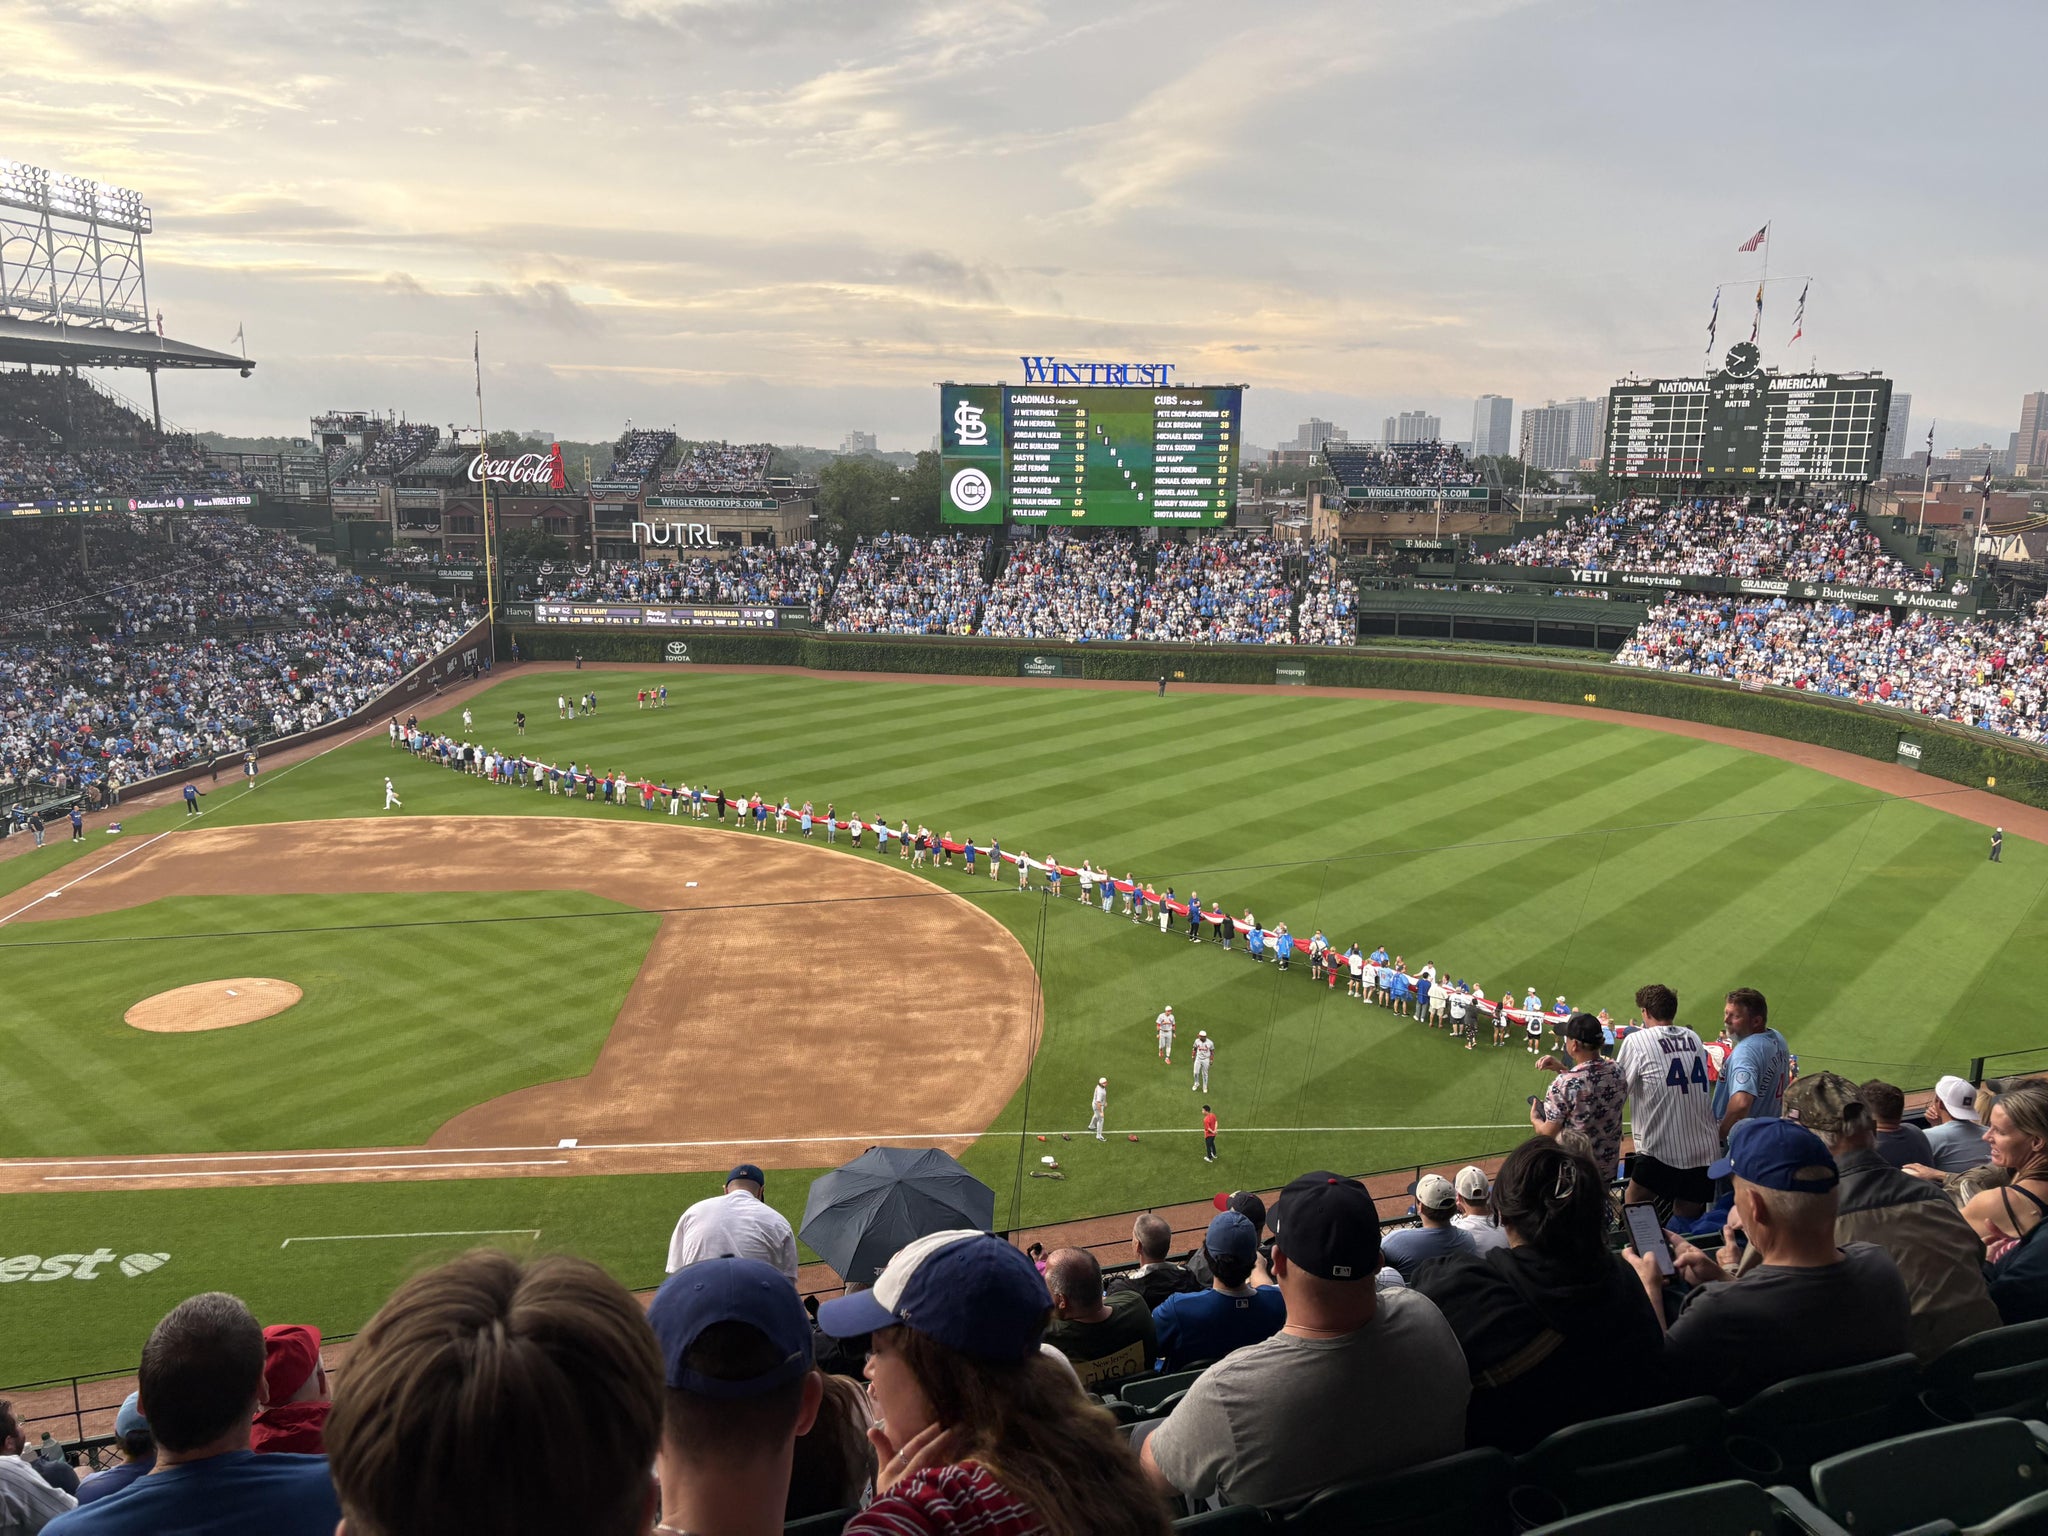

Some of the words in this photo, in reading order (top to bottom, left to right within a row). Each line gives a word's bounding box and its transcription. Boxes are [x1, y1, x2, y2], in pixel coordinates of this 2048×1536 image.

[1020, 356, 1175, 385] WINTRUST
[1658, 381, 1711, 393] NATIONAL
[1768, 378, 1828, 390] AMERICAN
[1011, 395, 1055, 404] CARDINALS
[1154, 396, 1178, 405] CUBS
[1724, 400, 1751, 408] BATTER
[1075, 454, 1084, 462] SS
[467, 452, 555, 484] Coca-Cola
[212, 497, 235, 506] WRIGLEY
[236, 497, 251, 505] FIELD
[661, 498, 763, 508] WRIGLEYROOFTOPS.COM
[1217, 500, 1226, 508] SS
[1414, 540, 1442, 549] Mobile
[1570, 569, 1608, 583] YETI
[1629, 576, 1682, 586] tastytrade
[1741, 579, 1789, 591] GRAINGER
[1908, 594, 1958, 609] Advocate
[506, 608, 533, 617] Harvey
[462, 648, 478, 667] YETI
[1276, 668, 1306, 676] Invenergy
[1584, 694, 1596, 702] 400
[1899, 742, 1922, 758] Hefty
[1658, 1036, 1696, 1054] RIZZO
[1666, 1056, 1708, 1094] 44
[0, 1248, 117, 1283] est
